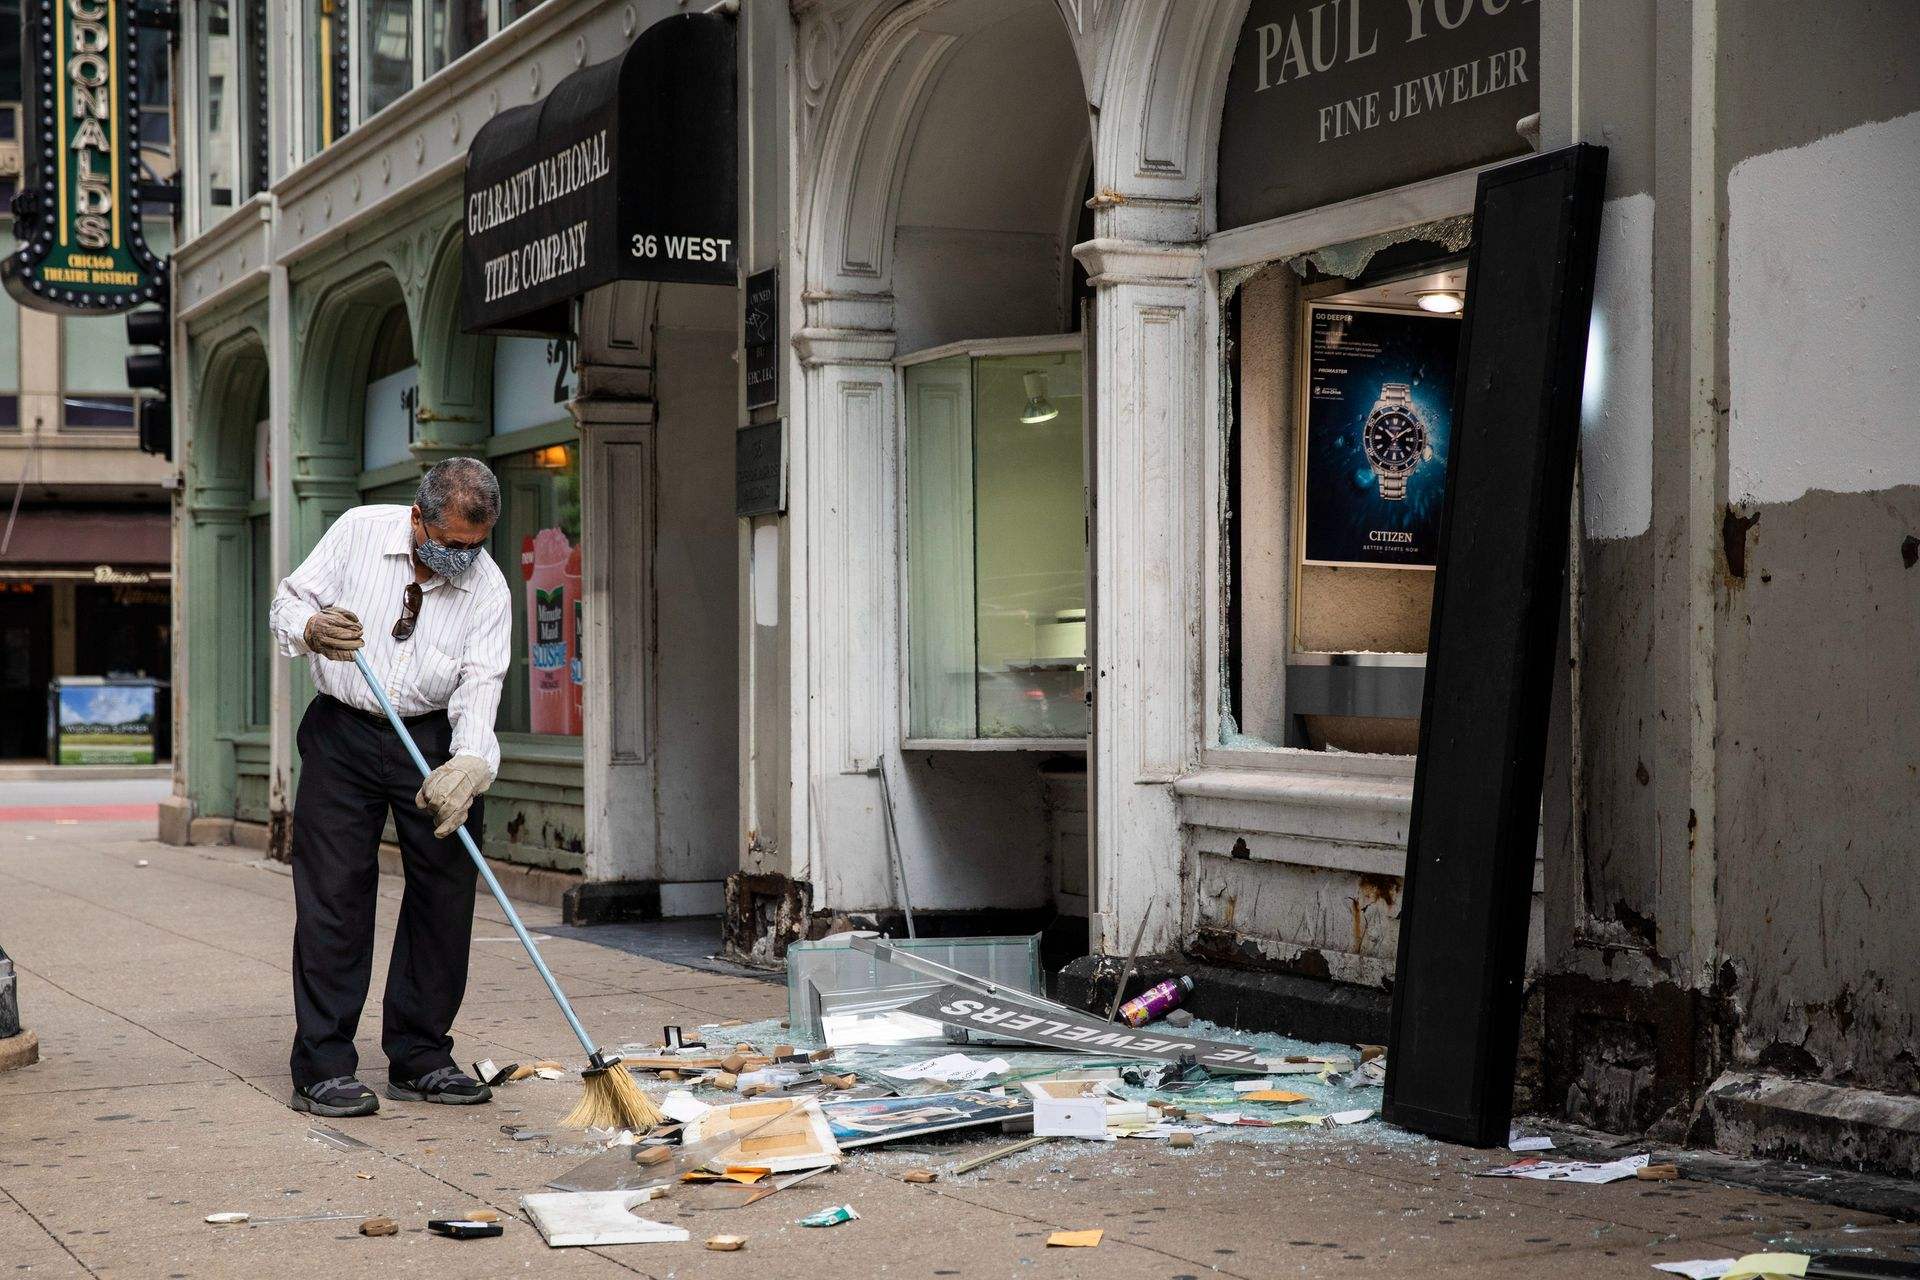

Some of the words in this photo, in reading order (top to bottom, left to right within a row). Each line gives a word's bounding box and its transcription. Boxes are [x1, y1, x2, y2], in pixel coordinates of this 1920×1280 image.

[1254, 0, 1378, 93] PAUL
[1318, 91, 1381, 144] FINE
[1388, 46, 1529, 123] JEWELER
[468, 163, 538, 237] GUARANTY
[537, 129, 610, 204] NATIONAL
[630, 233, 658, 258] 36
[664, 234, 732, 263] WEST
[67, 254, 115, 270] CHICAGO
[484, 250, 521, 304] TITLE
[521, 220, 588, 290] COMPANY
[43, 267, 89, 283] THEATRE
[91, 271, 139, 287] DISTRICT
[1326, 313, 1353, 322] DEEPER
[1369, 530, 1413, 543] CITIZEN
[537, 604, 562, 623] Minute
[540, 621, 559, 640] Maid
[939, 999, 1197, 1052] JEWELERS
